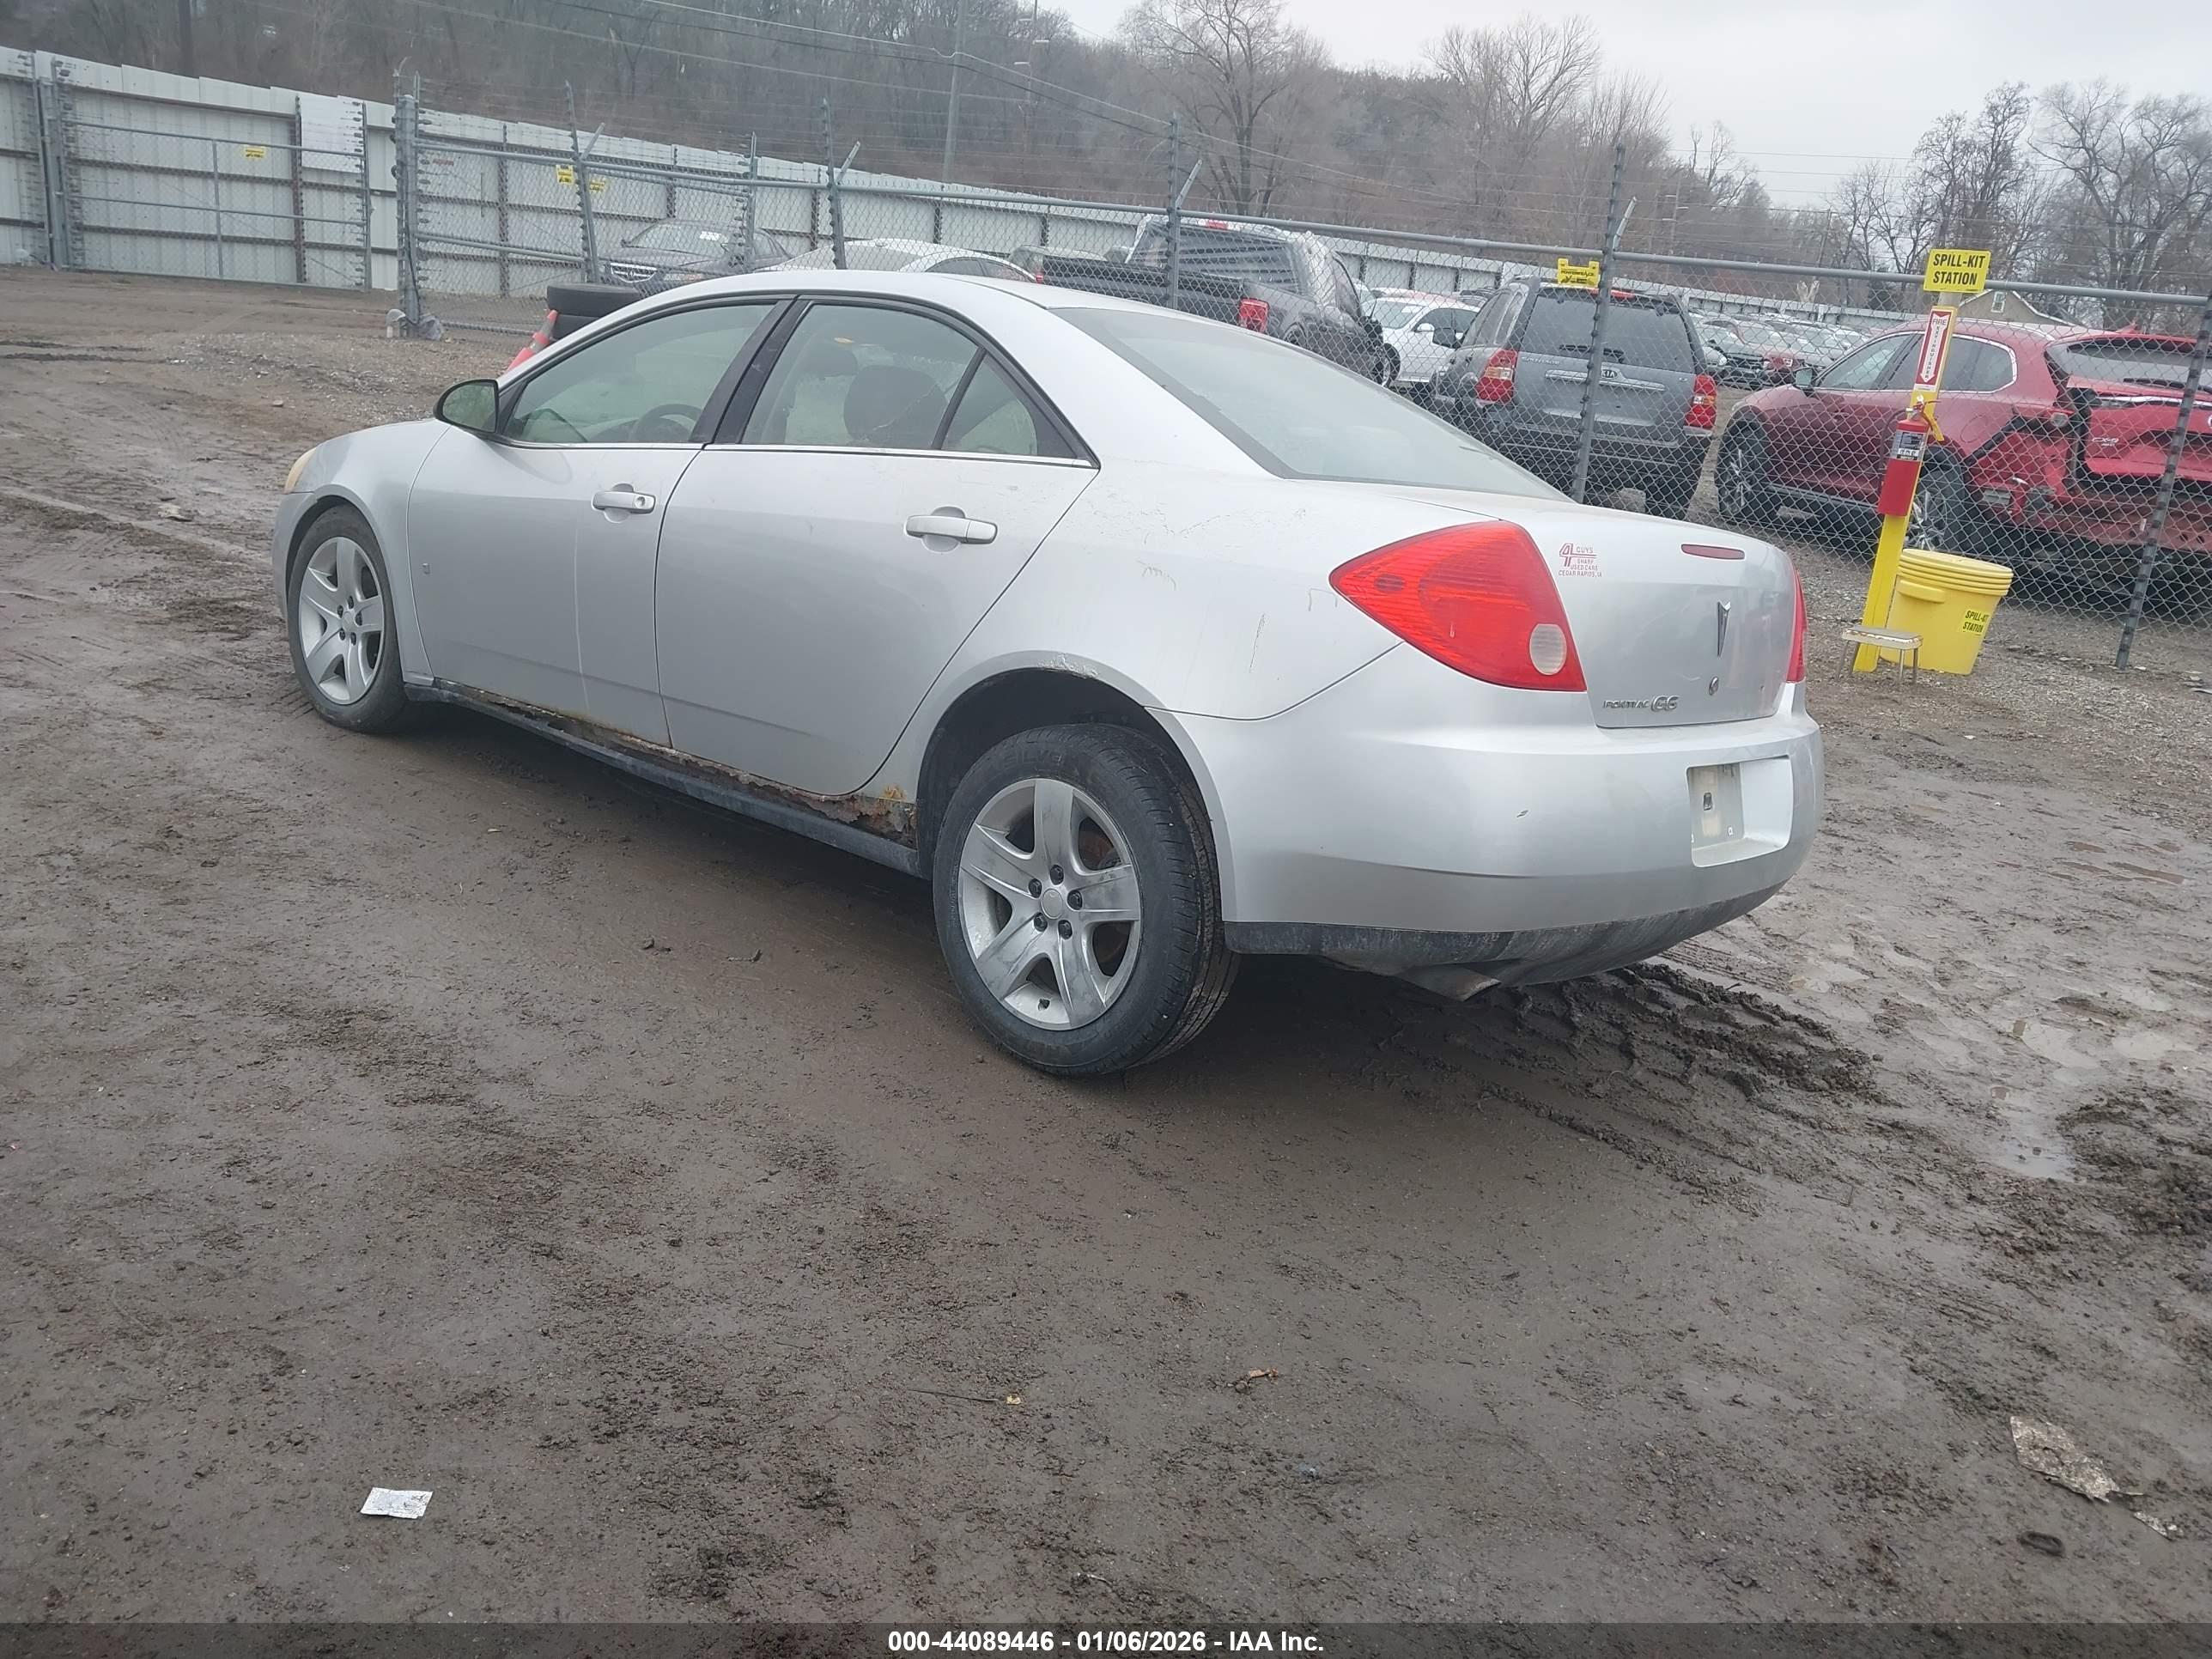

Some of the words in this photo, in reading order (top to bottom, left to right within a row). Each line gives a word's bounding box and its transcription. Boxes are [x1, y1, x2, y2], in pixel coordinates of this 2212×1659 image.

[1933, 253, 1986, 269] SPILL-KIT
[1933, 271, 1978, 285] STATION
[1932, 318, 1948, 326] FIRE
